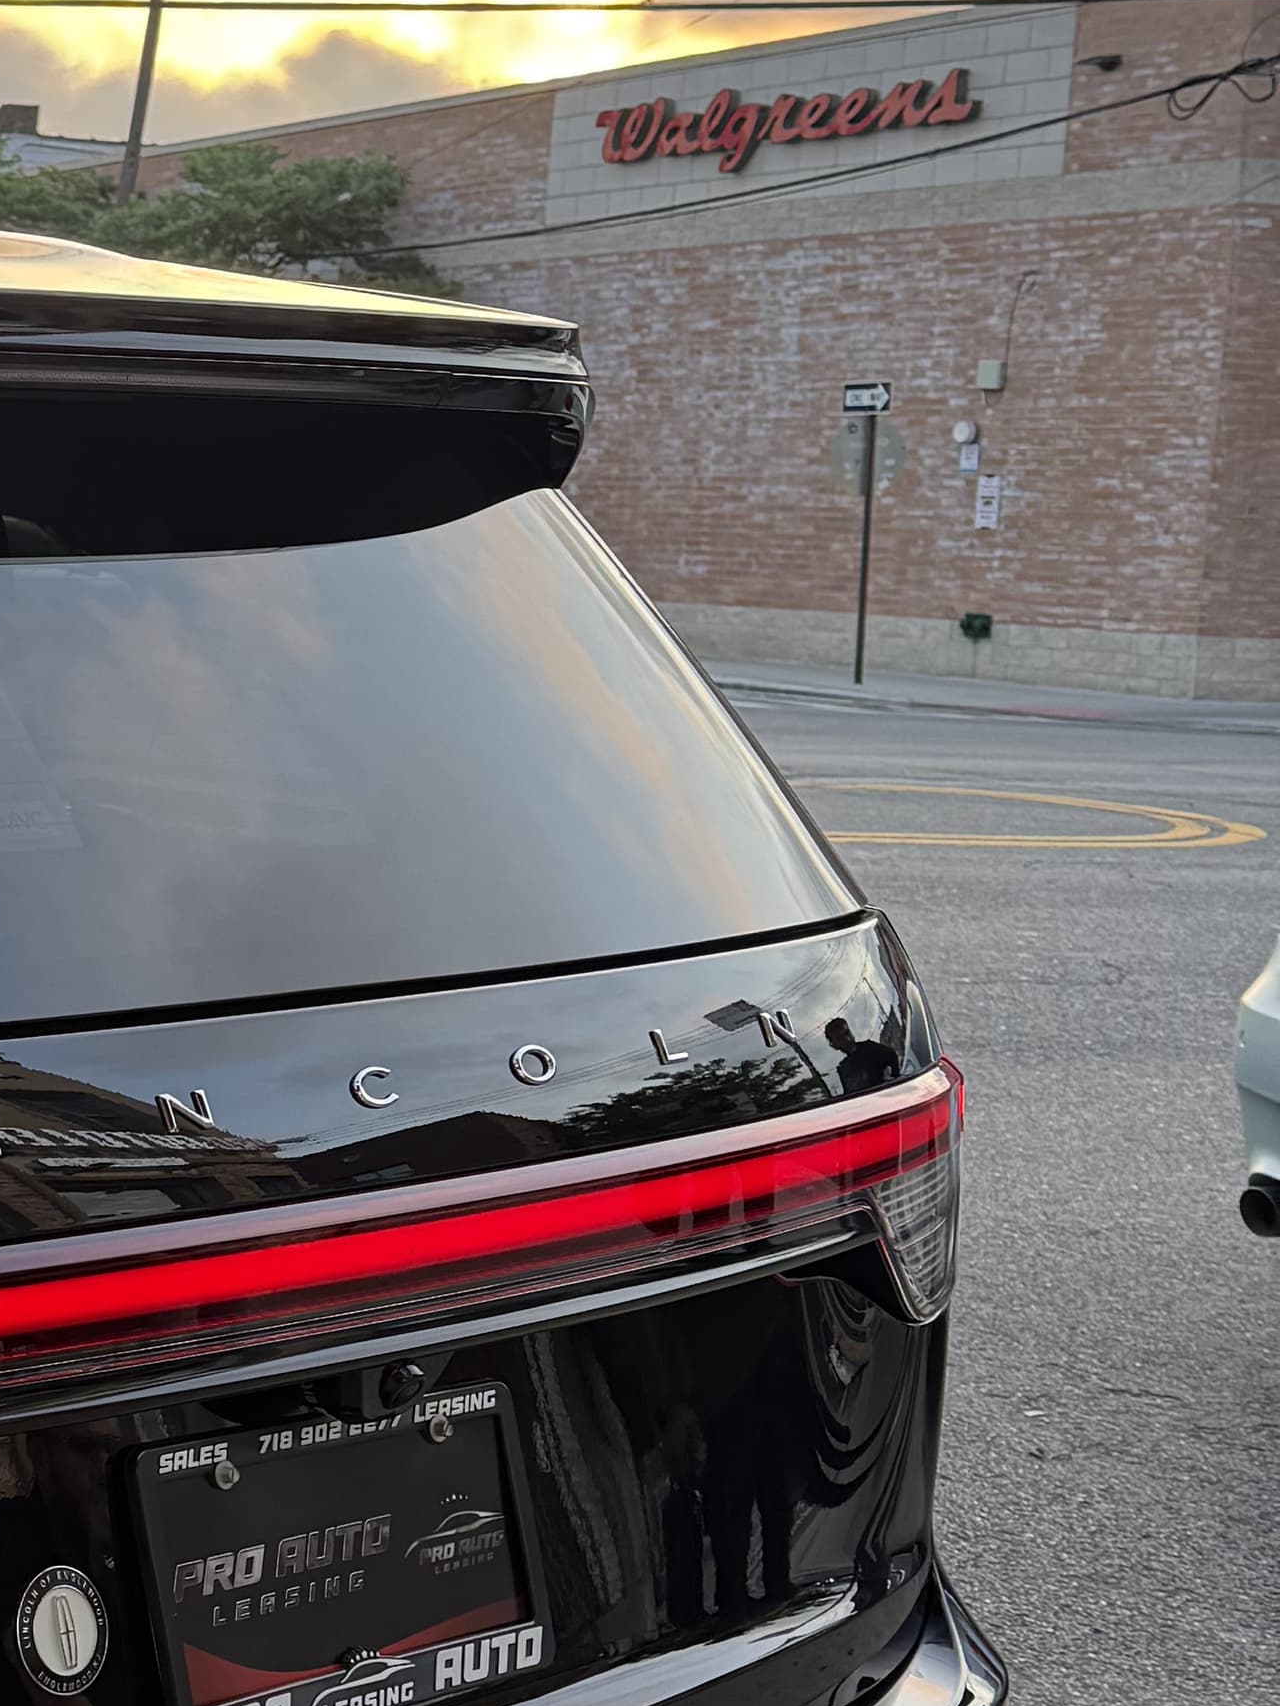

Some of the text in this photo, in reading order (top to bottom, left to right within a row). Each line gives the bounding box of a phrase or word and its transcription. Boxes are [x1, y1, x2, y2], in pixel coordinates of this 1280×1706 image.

[596, 68, 981, 173] Walgreens
[158, 1441, 229, 1475] SALES
[257, 1432, 294, 1455] 718
[299, 1421, 343, 1447] 902
[412, 1389, 497, 1424] LEASING
[172, 1512, 393, 1604] PRO AUTO
[419, 1541, 456, 1567] PRO
[211, 1569, 367, 1628] LEASING
[434, 1624, 543, 1693] AUTO
